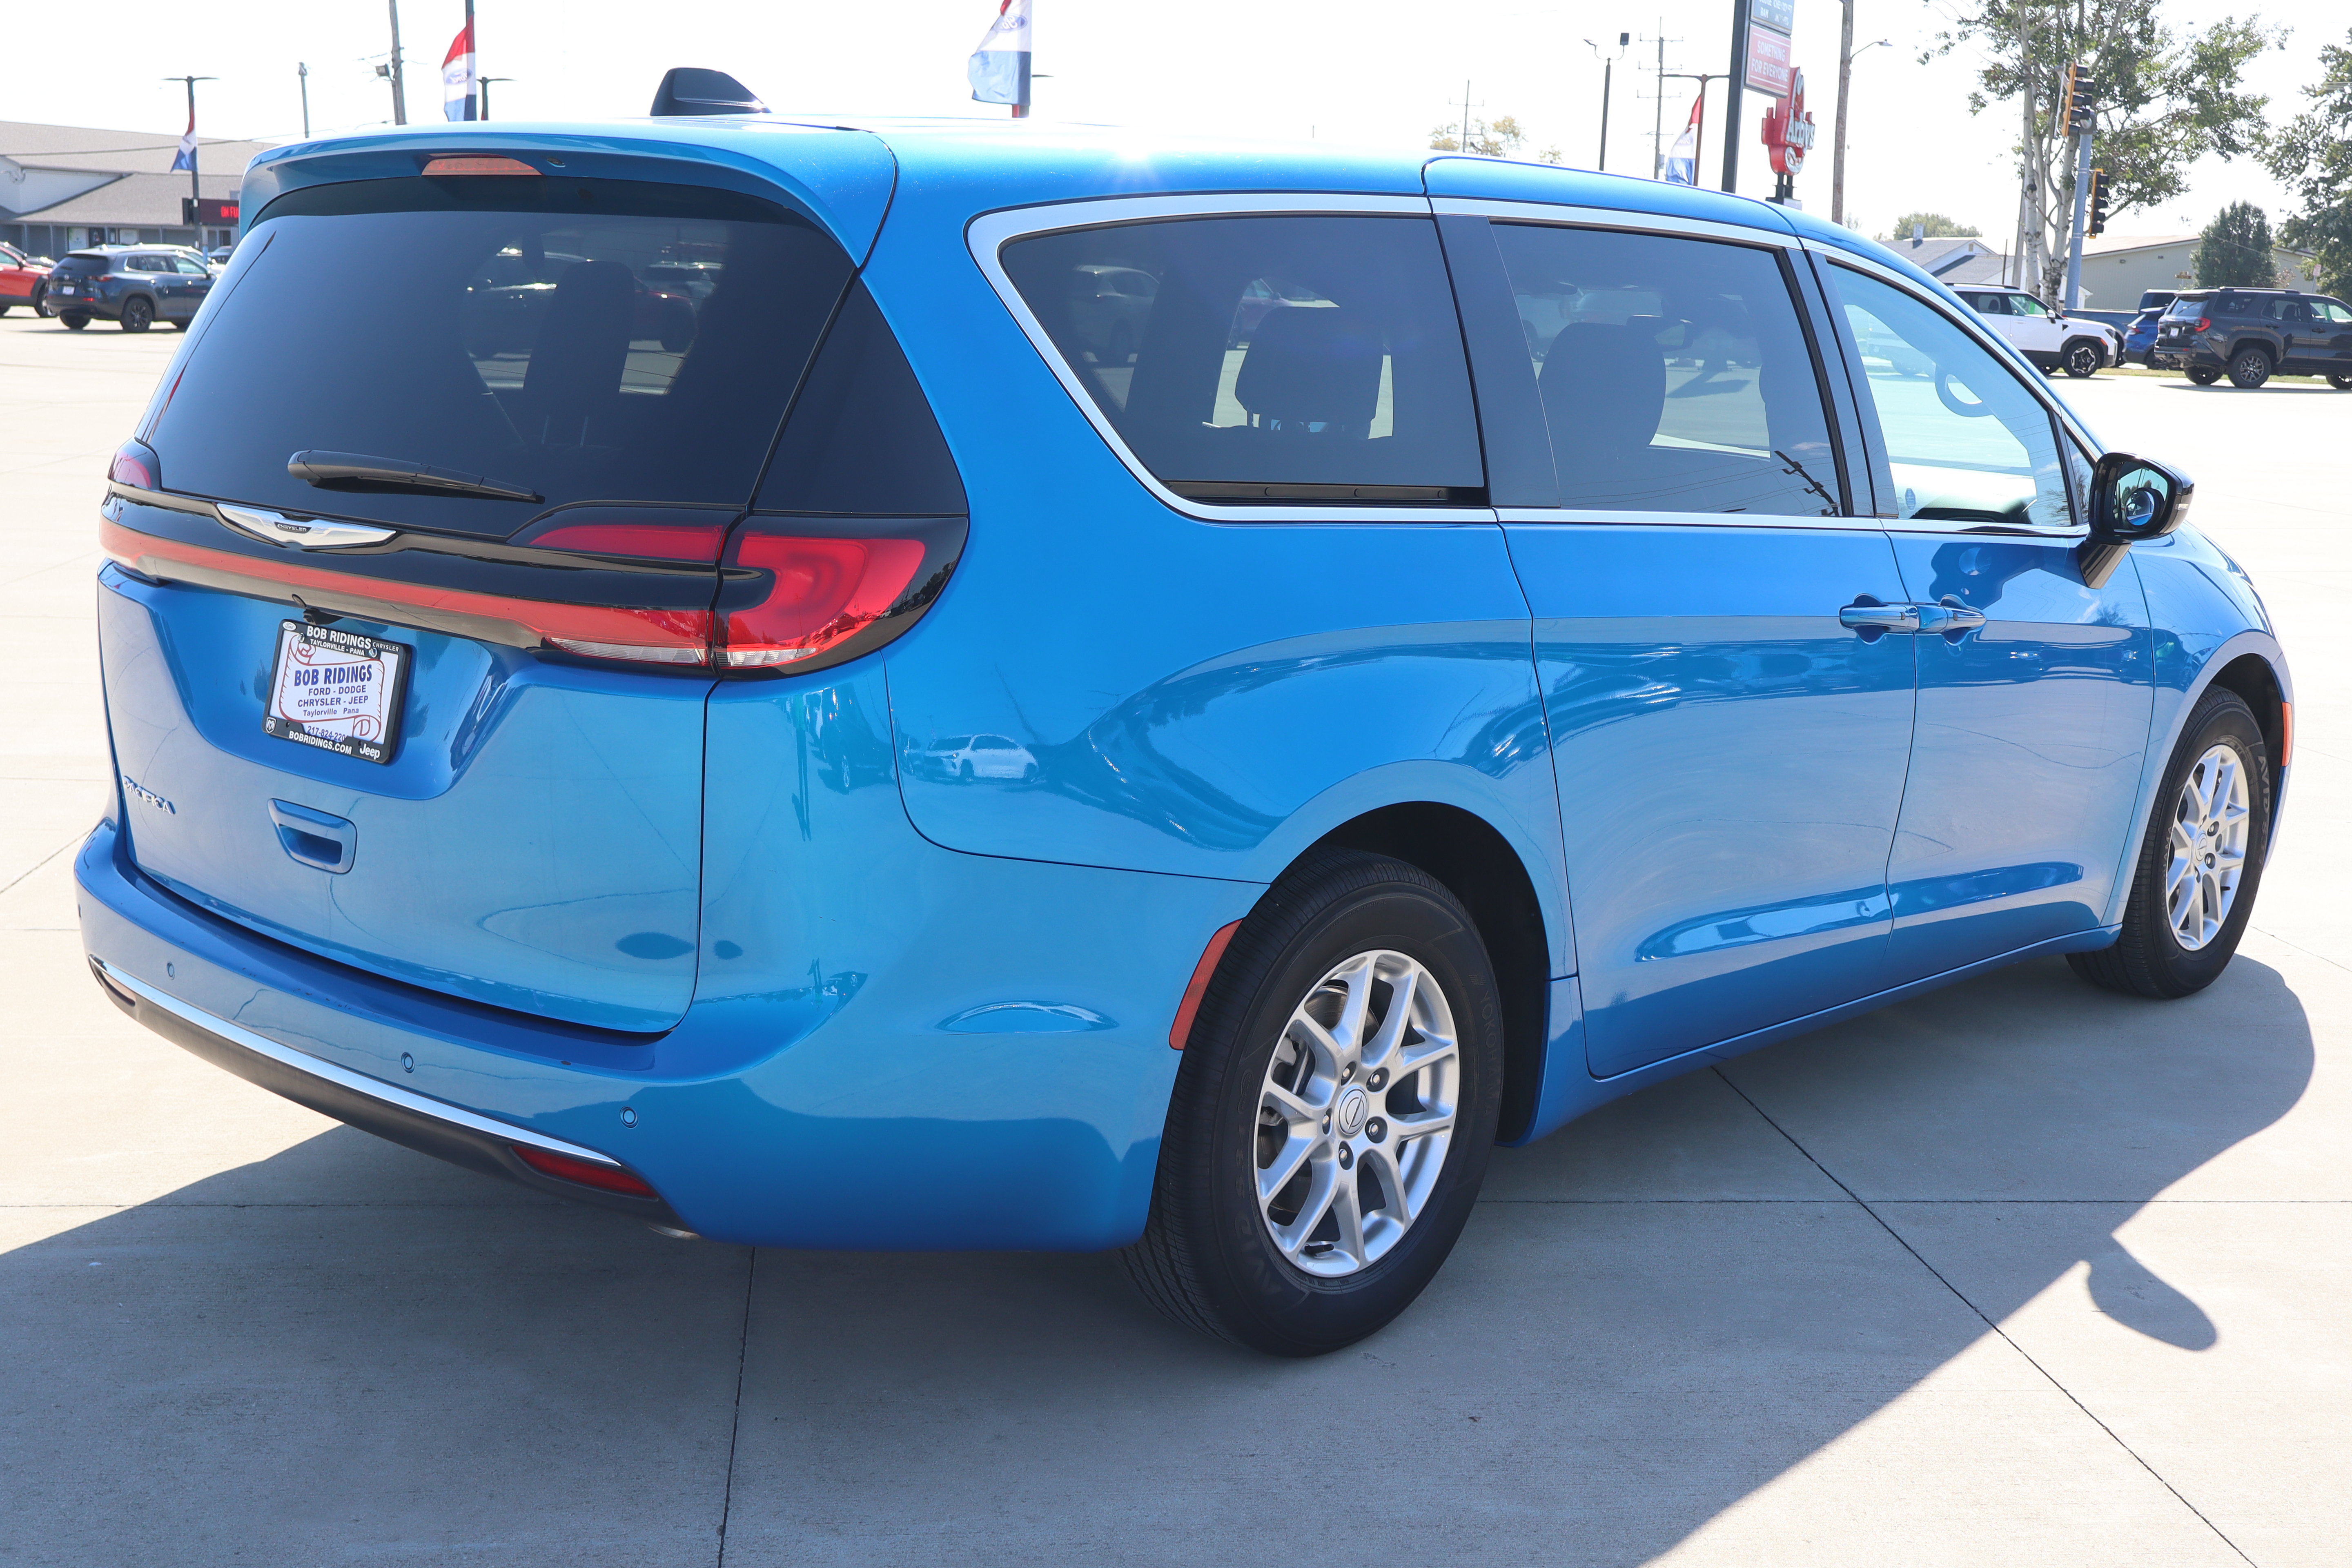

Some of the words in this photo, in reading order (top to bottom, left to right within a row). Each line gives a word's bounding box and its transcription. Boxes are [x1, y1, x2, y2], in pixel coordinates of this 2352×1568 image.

[1757, 40, 1785, 62] SOMETHING
[1751, 58, 1762, 74] FOR
[1763, 61, 1788, 82] EVERYONE
[307, 626, 327, 639] BOB
[330, 630, 372, 649] RIDINGS
[310, 638, 345, 652] TAYLORVILLE
[350, 648, 365, 656] PANA
[372, 641, 399, 652] CHRYSLER
[294, 669, 319, 686] BOB
[324, 664, 372, 684] RIDINGS
[308, 687, 331, 696] FORD
[339, 685, 366, 694] DODGE
[298, 697, 341, 708] CHRYSLER
[348, 695, 368, 704] JEEP
[303, 709, 337, 717] Taylorville
[289, 730, 352, 755] BOBRIDINGS.COM
[307, 726, 348, 742] 217-824-220
[359, 743, 380, 760] Jeep
[122, 775, 176, 815] PACIFICA
[1479, 989, 1498, 1118] YOKOHAMA
